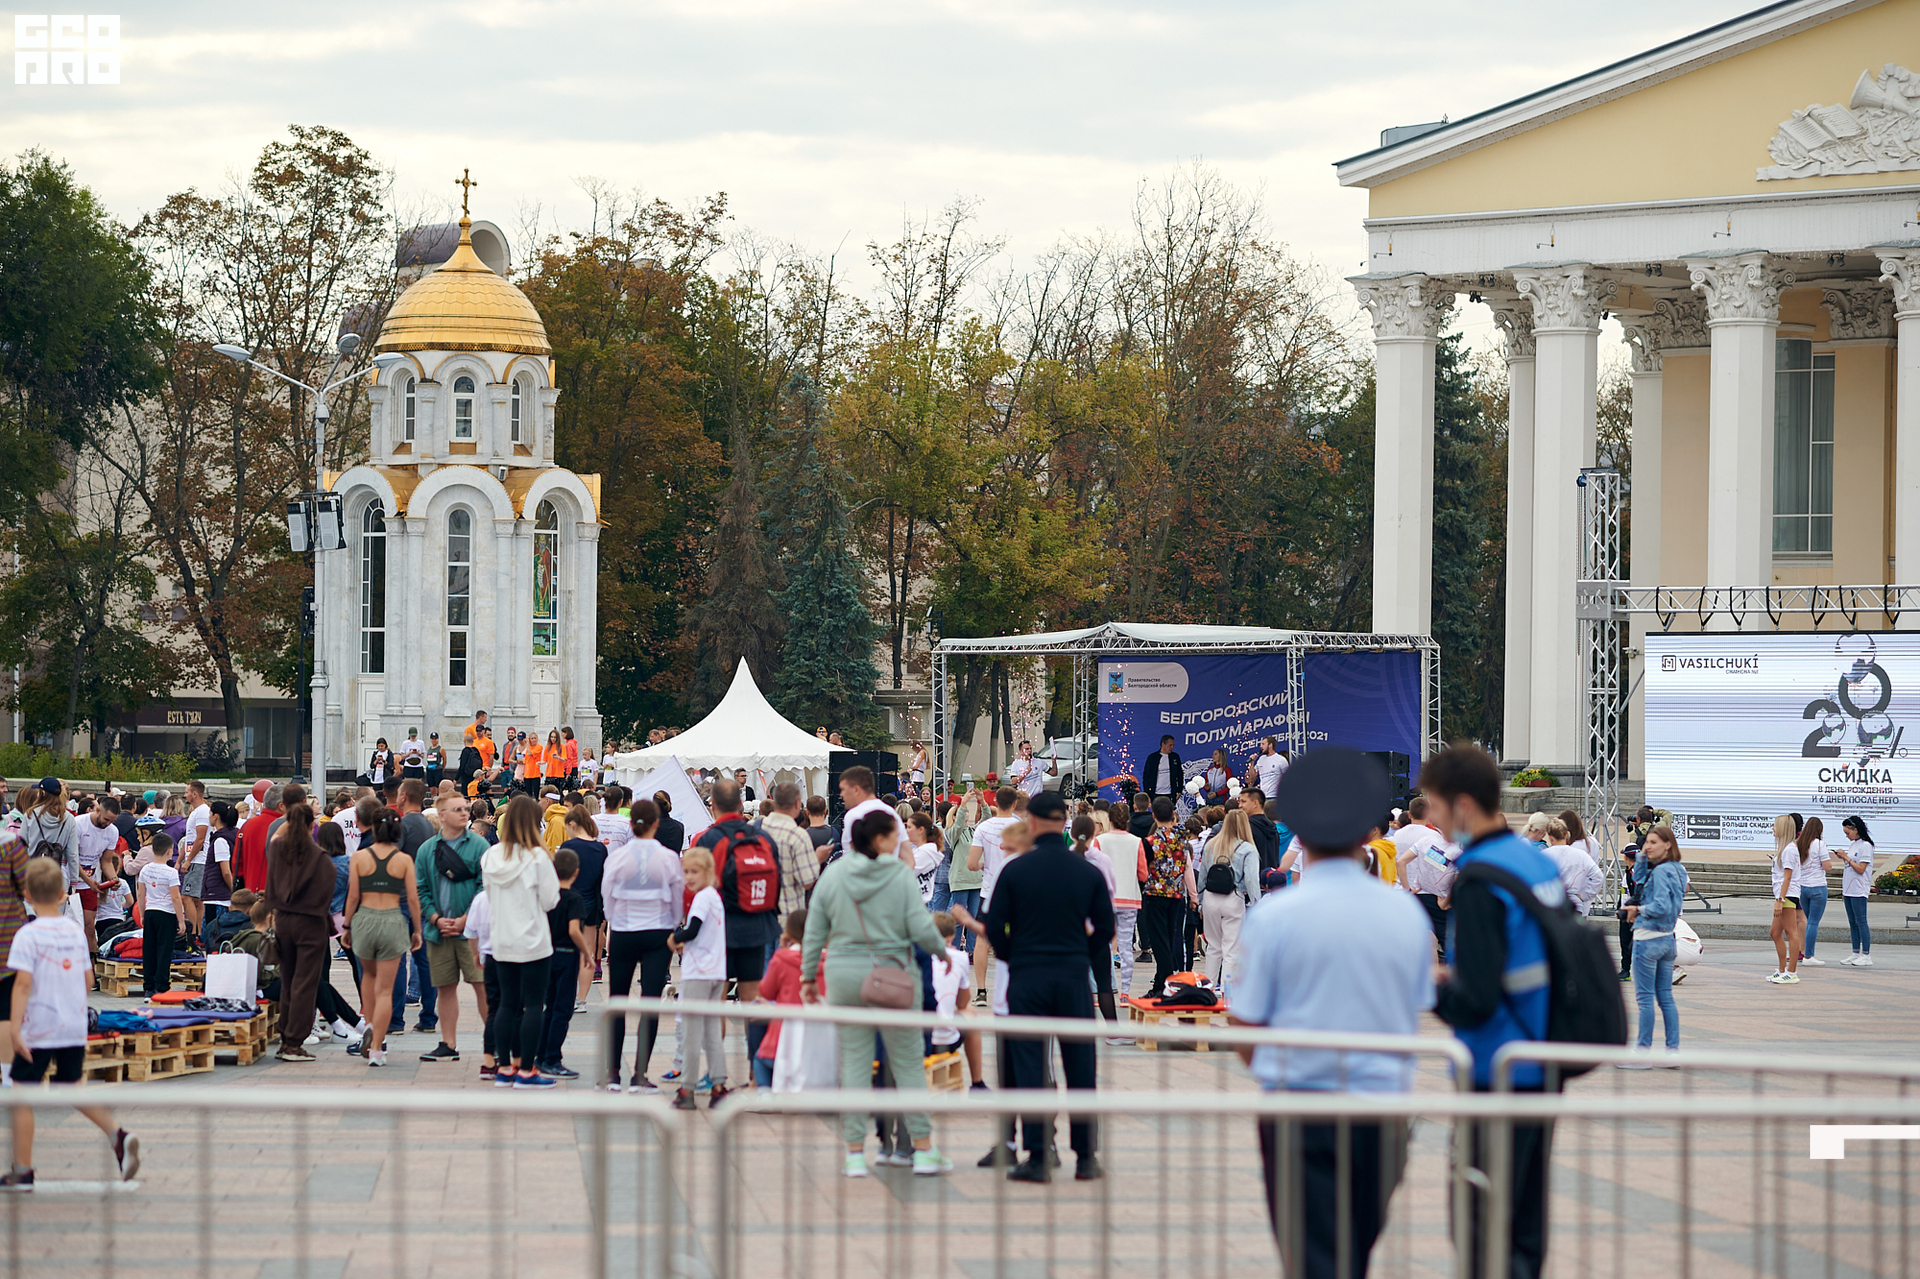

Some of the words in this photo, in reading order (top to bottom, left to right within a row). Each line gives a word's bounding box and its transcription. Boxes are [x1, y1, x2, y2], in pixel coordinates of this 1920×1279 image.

[1160, 689, 1291, 725] БЕЛГОРОДСКИЙ
[1185, 711, 1311, 745] ПОЛУМАРАФОН
[1228, 743, 1240, 755] 12
[1818, 767, 1893, 785] СКИДКА
[1825, 786, 1845, 794] ДЕНЬ
[1847, 786, 1893, 794] РОЖДЕНИЯ
[1811, 795, 1818, 803] И
[1819, 795, 1824, 803] 6
[1826, 794, 1847, 804] ДНЕЙ
[1849, 796, 1878, 804] ПОСЛЕ
[1878, 796, 1900, 805] НЕГО
